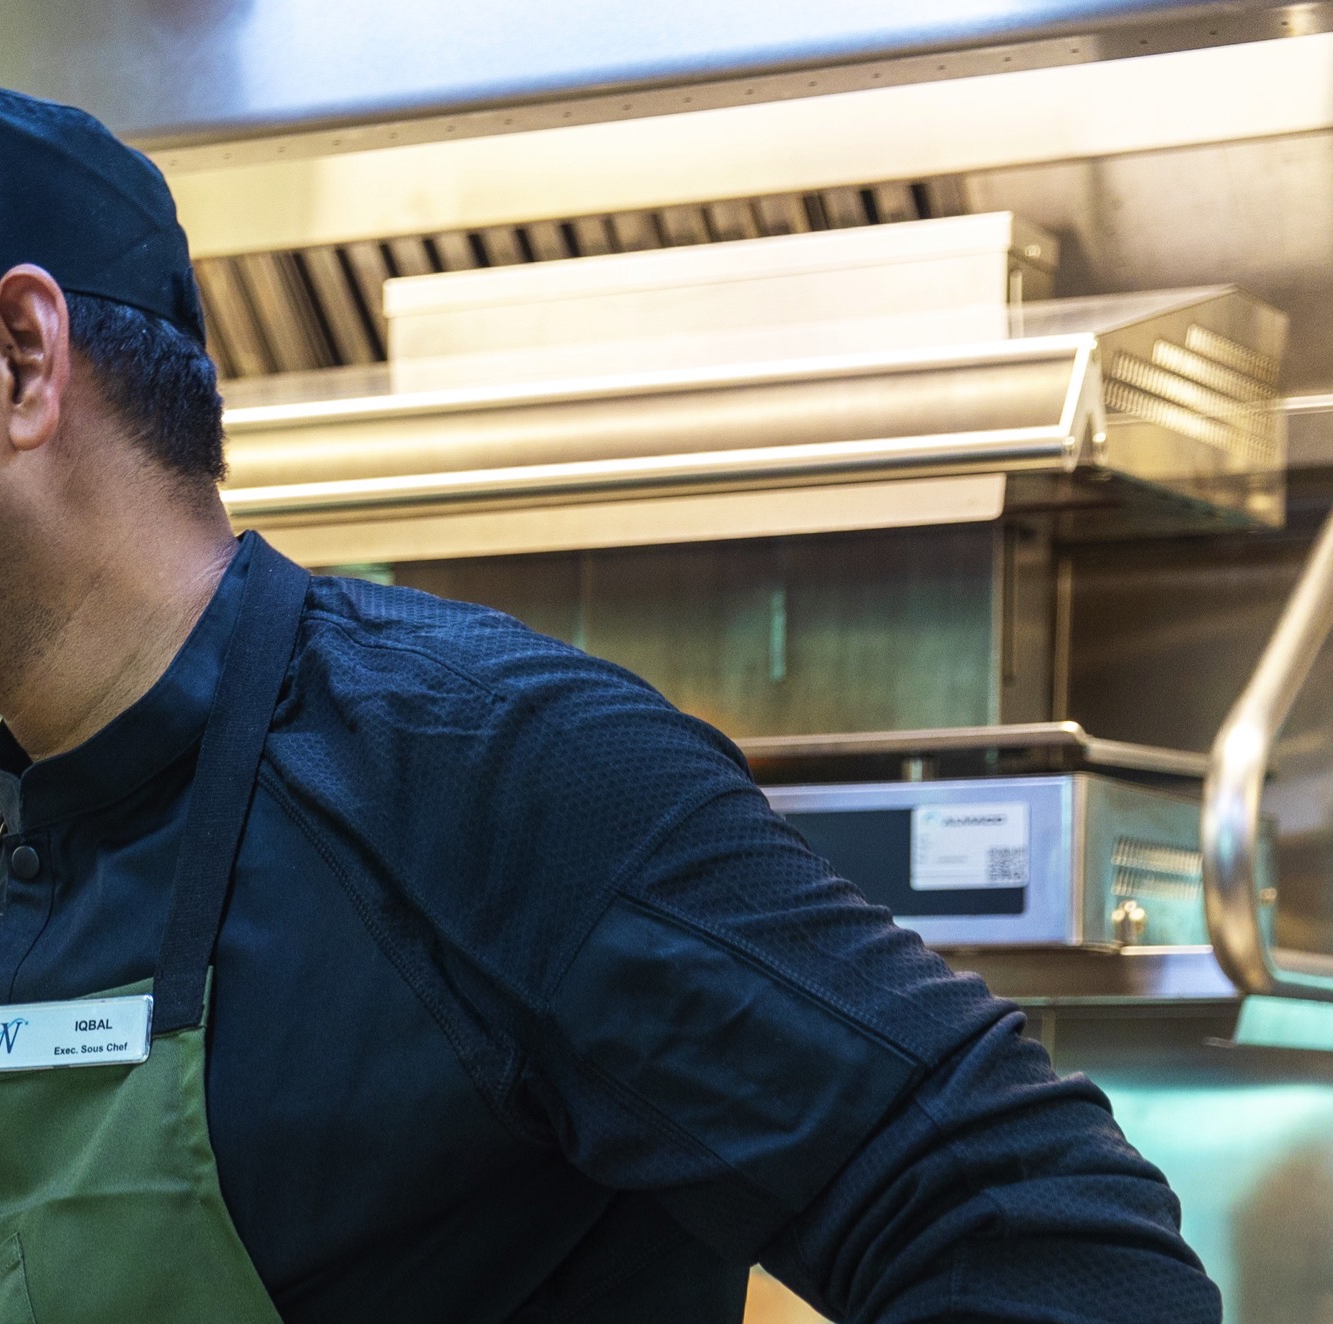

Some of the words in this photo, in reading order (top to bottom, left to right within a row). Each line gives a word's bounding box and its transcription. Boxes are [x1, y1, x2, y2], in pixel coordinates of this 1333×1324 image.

[74, 1018, 113, 1032] IQBAL
[53, 1046, 78, 1056] Exec.
[80, 1044, 104, 1054] Sous
[106, 1042, 128, 1052] Chef
